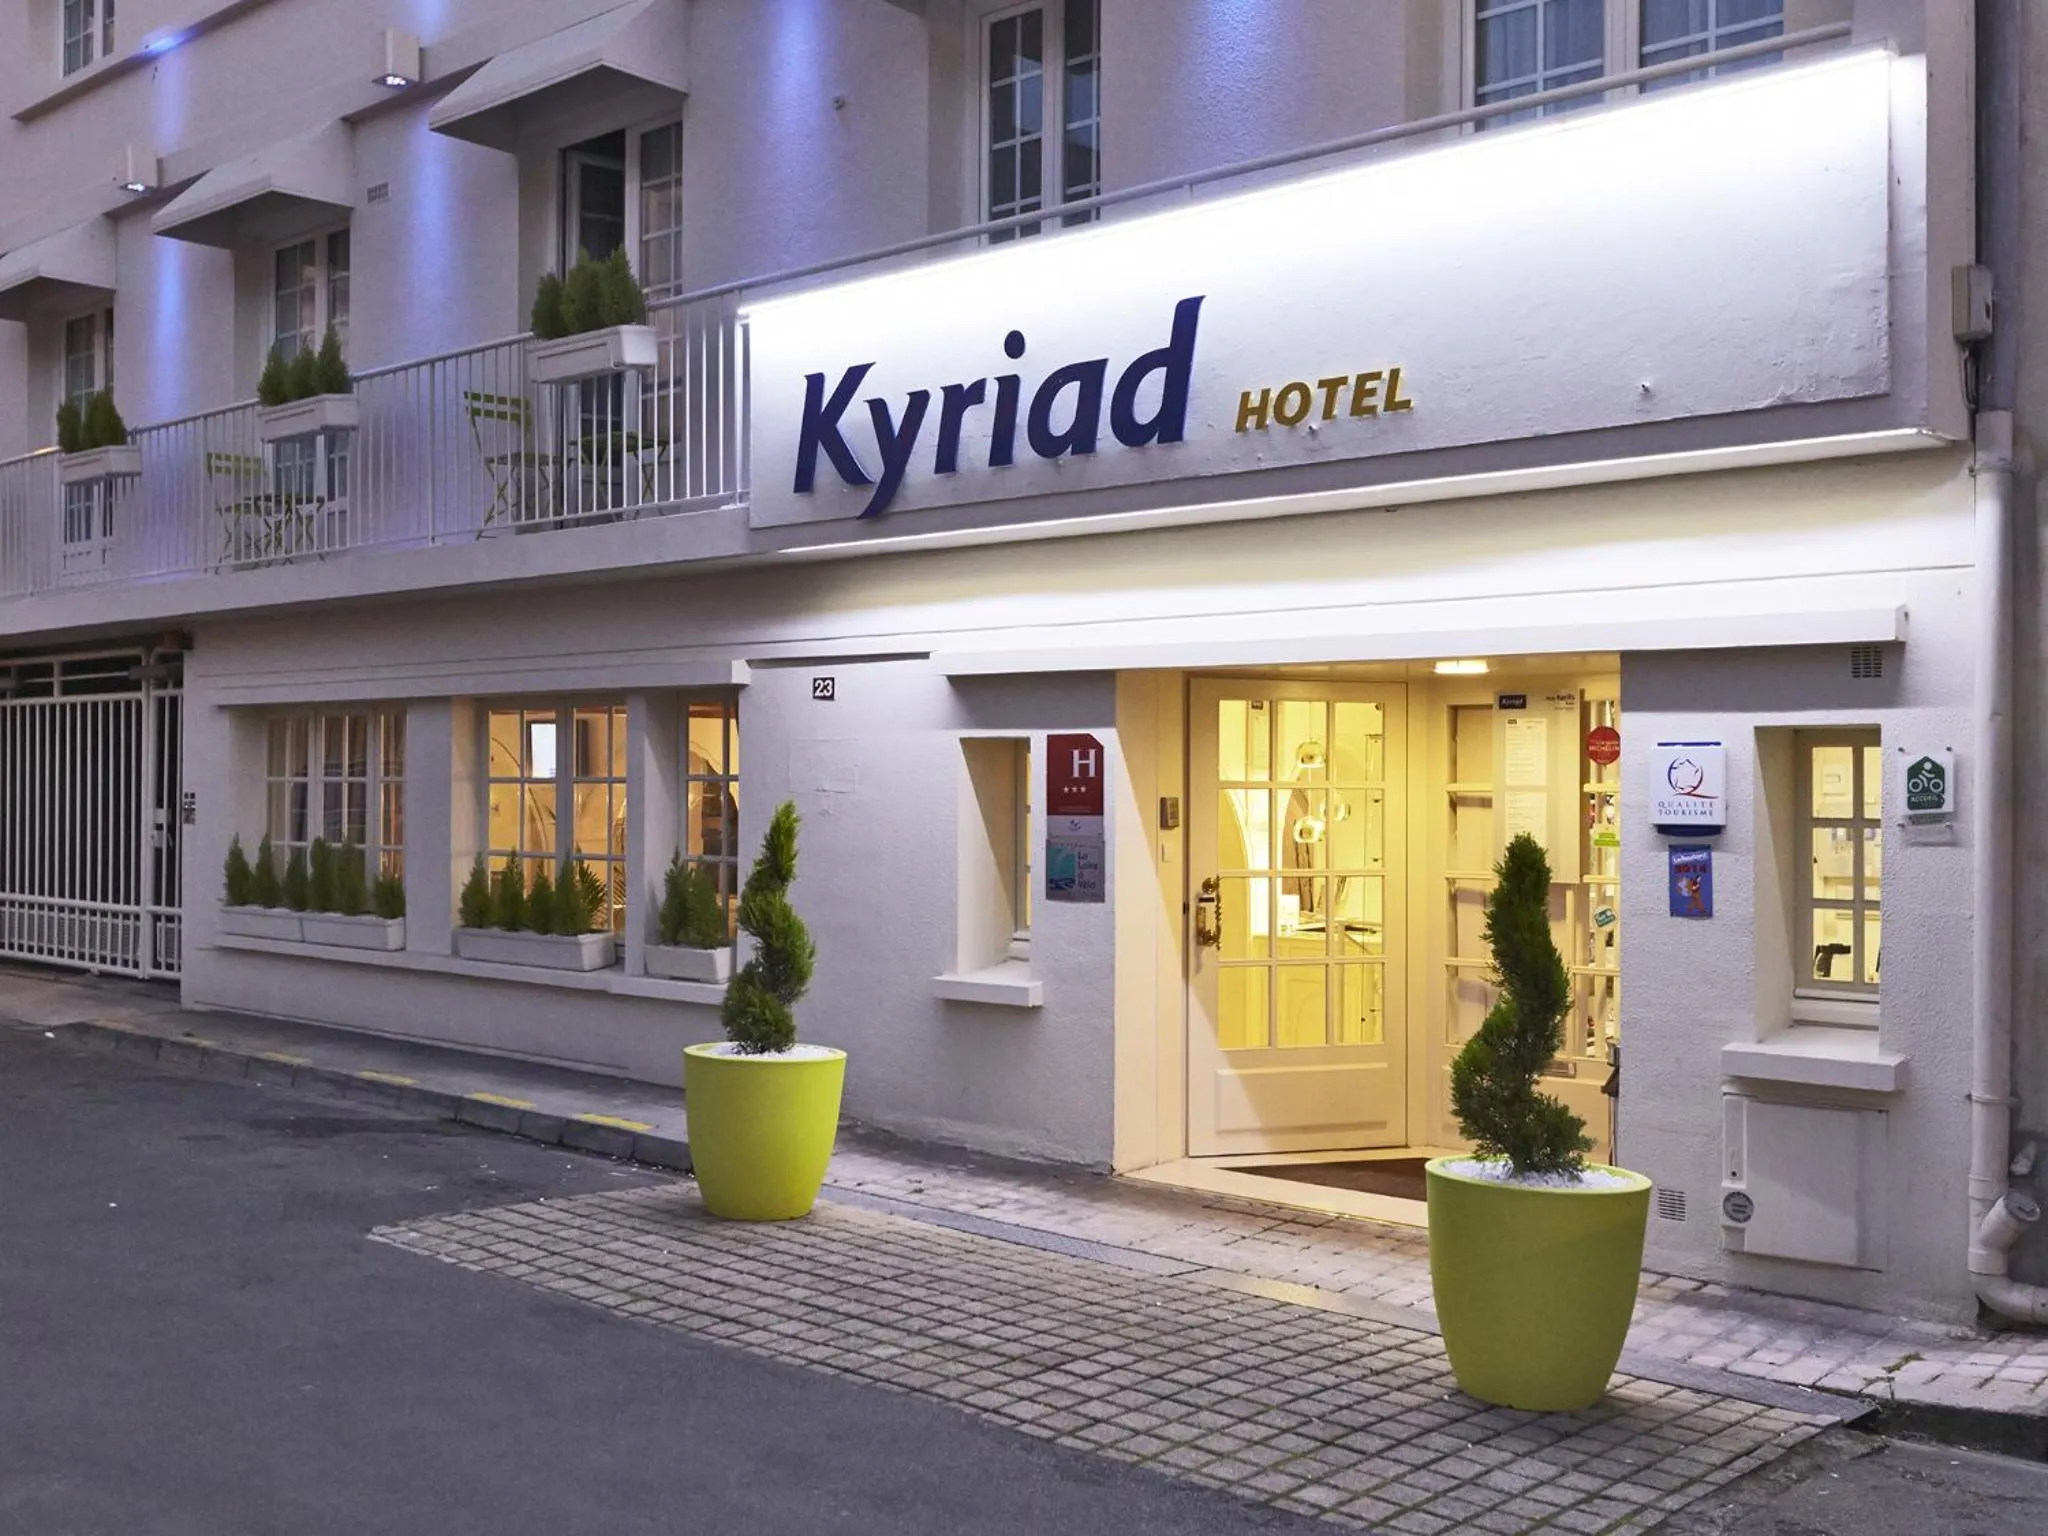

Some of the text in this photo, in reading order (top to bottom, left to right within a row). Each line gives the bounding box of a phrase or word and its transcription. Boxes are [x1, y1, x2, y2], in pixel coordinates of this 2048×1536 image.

[793, 295, 1413, 519] Kyriad HOTEL
[814, 679, 834, 697] 23
[1071, 749, 1096, 778] H
[1658, 809, 1714, 817] TOURISME
